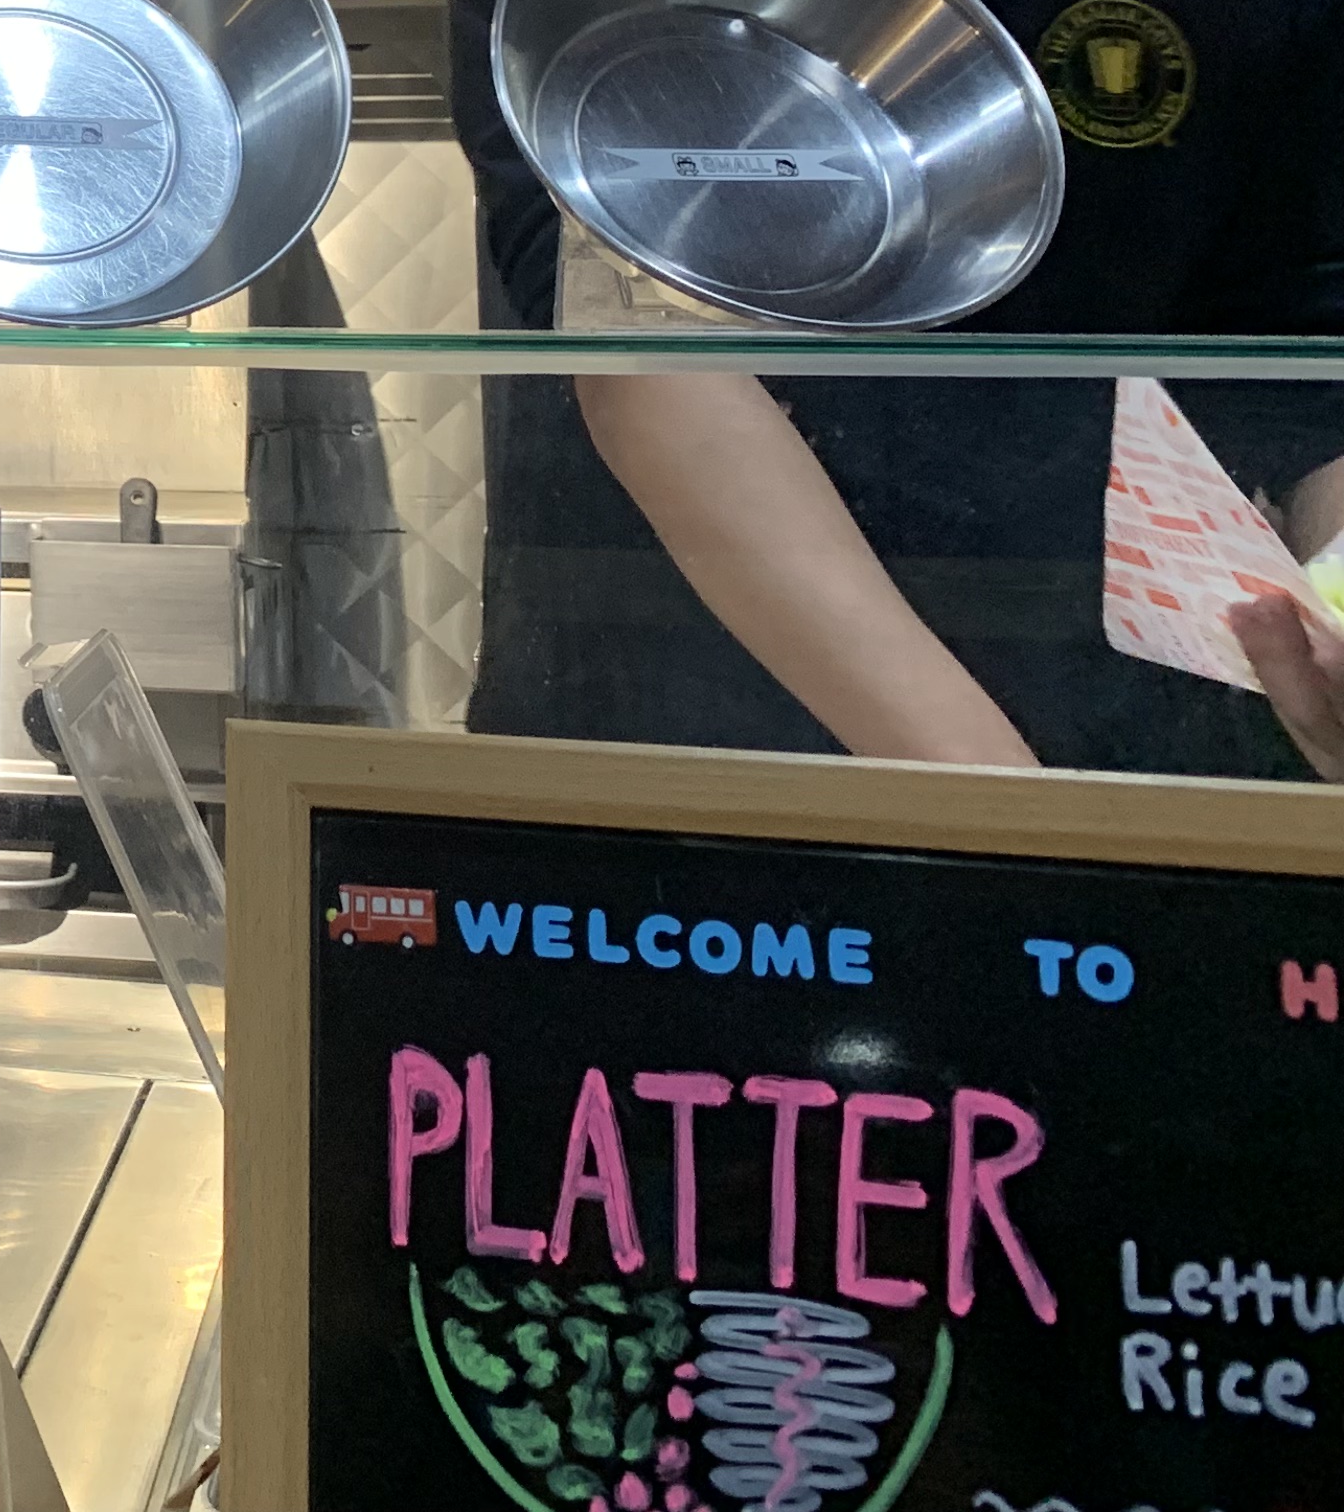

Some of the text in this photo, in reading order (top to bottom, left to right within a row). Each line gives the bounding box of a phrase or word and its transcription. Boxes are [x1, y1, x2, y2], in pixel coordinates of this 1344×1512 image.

[701, 155, 772, 174] SMALL
[455, 900, 874, 984] WELCOME
[1023, 938, 1135, 1003] TO
[388, 1043, 1060, 1326] PLATTER
[1120, 1238, 1344, 1333] Lettu
[1120, 1329, 1317, 1429] Rice
